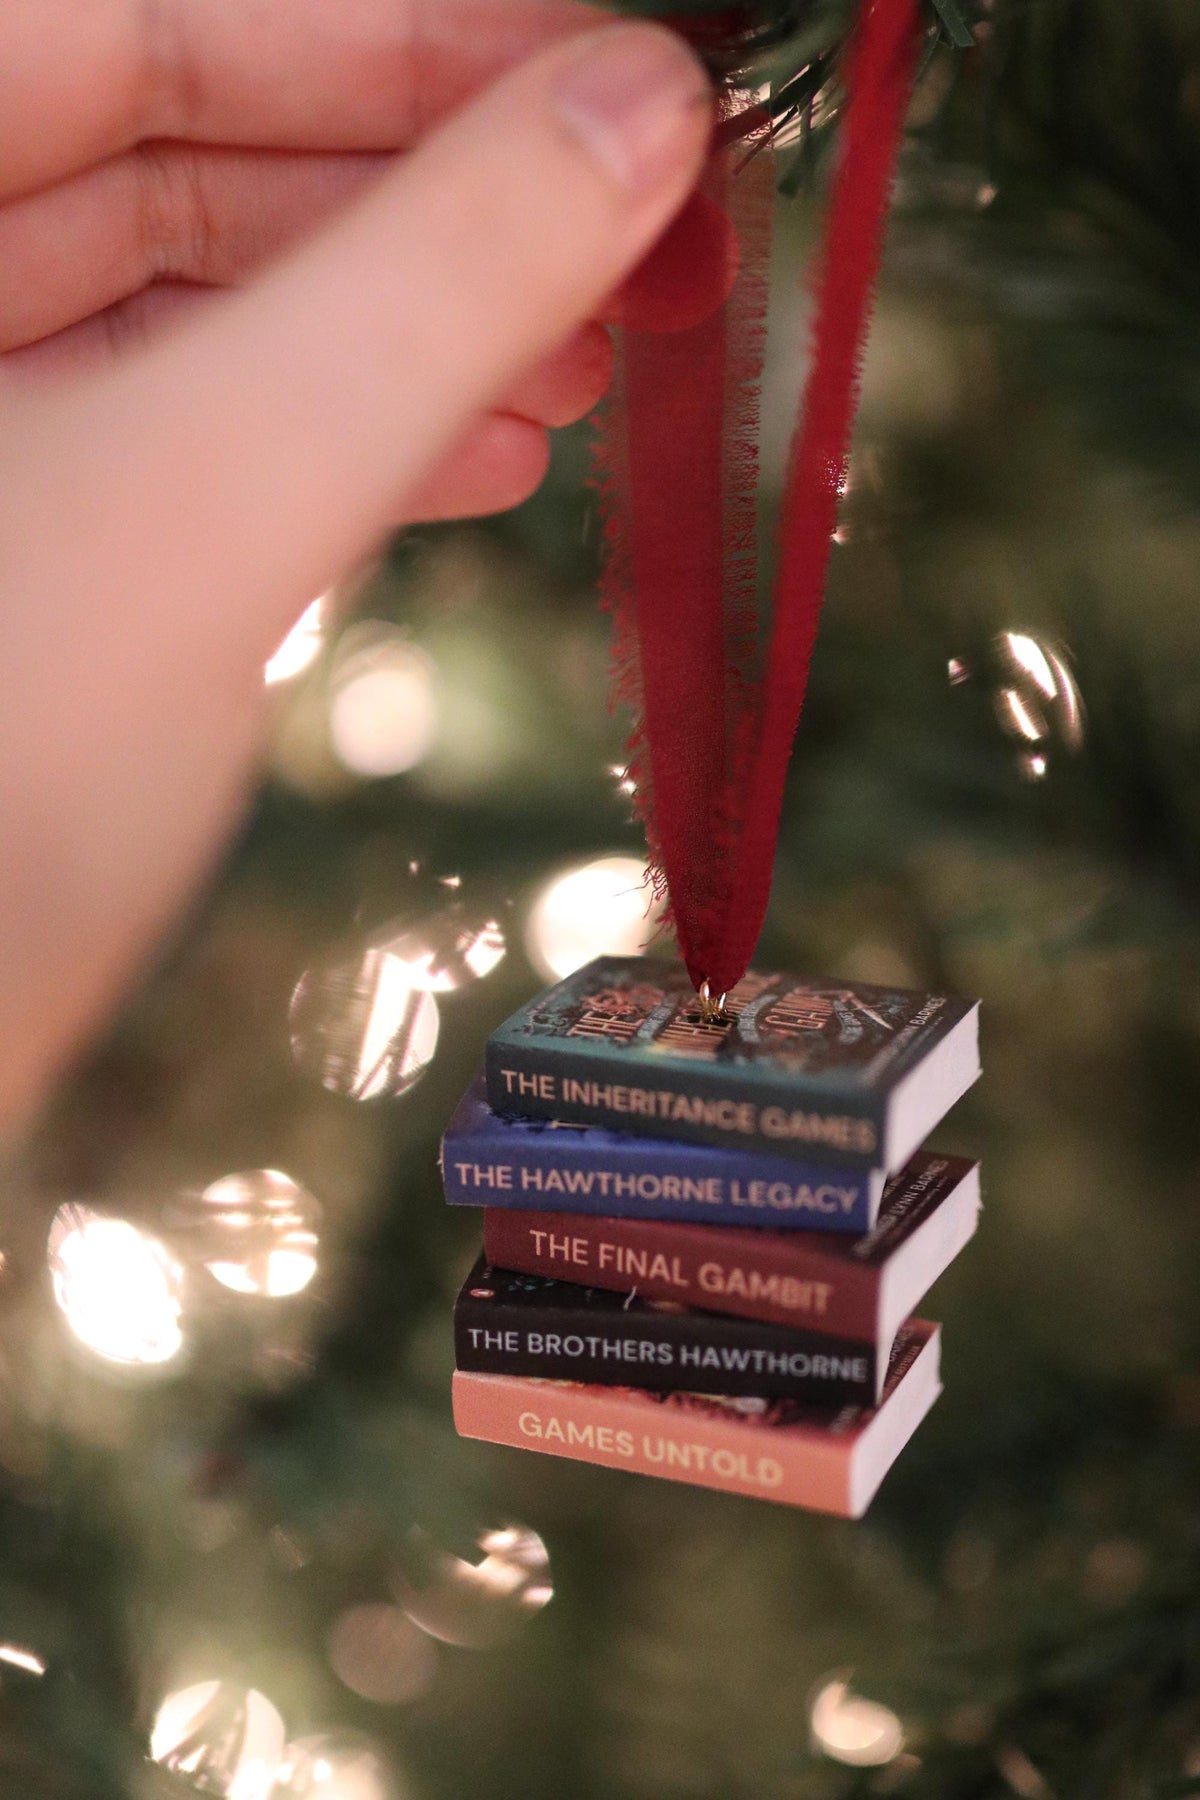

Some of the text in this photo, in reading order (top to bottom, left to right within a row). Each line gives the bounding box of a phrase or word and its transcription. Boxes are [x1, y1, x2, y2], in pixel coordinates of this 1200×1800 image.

[501, 1069, 878, 1153] THE INHERITANCE GAMES
[454, 1162, 513, 1190] THE
[520, 1166, 723, 1205] HAWTHORNE
[729, 1178, 860, 1214] LEGACY
[529, 1229, 834, 1314] THE FINAL GAMBIT
[468, 1328, 519, 1354] THE
[527, 1332, 674, 1366] BROTHERS
[680, 1346, 868, 1384] HAWTHORNE
[518, 1411, 784, 1489] GAMES UNTOLD
